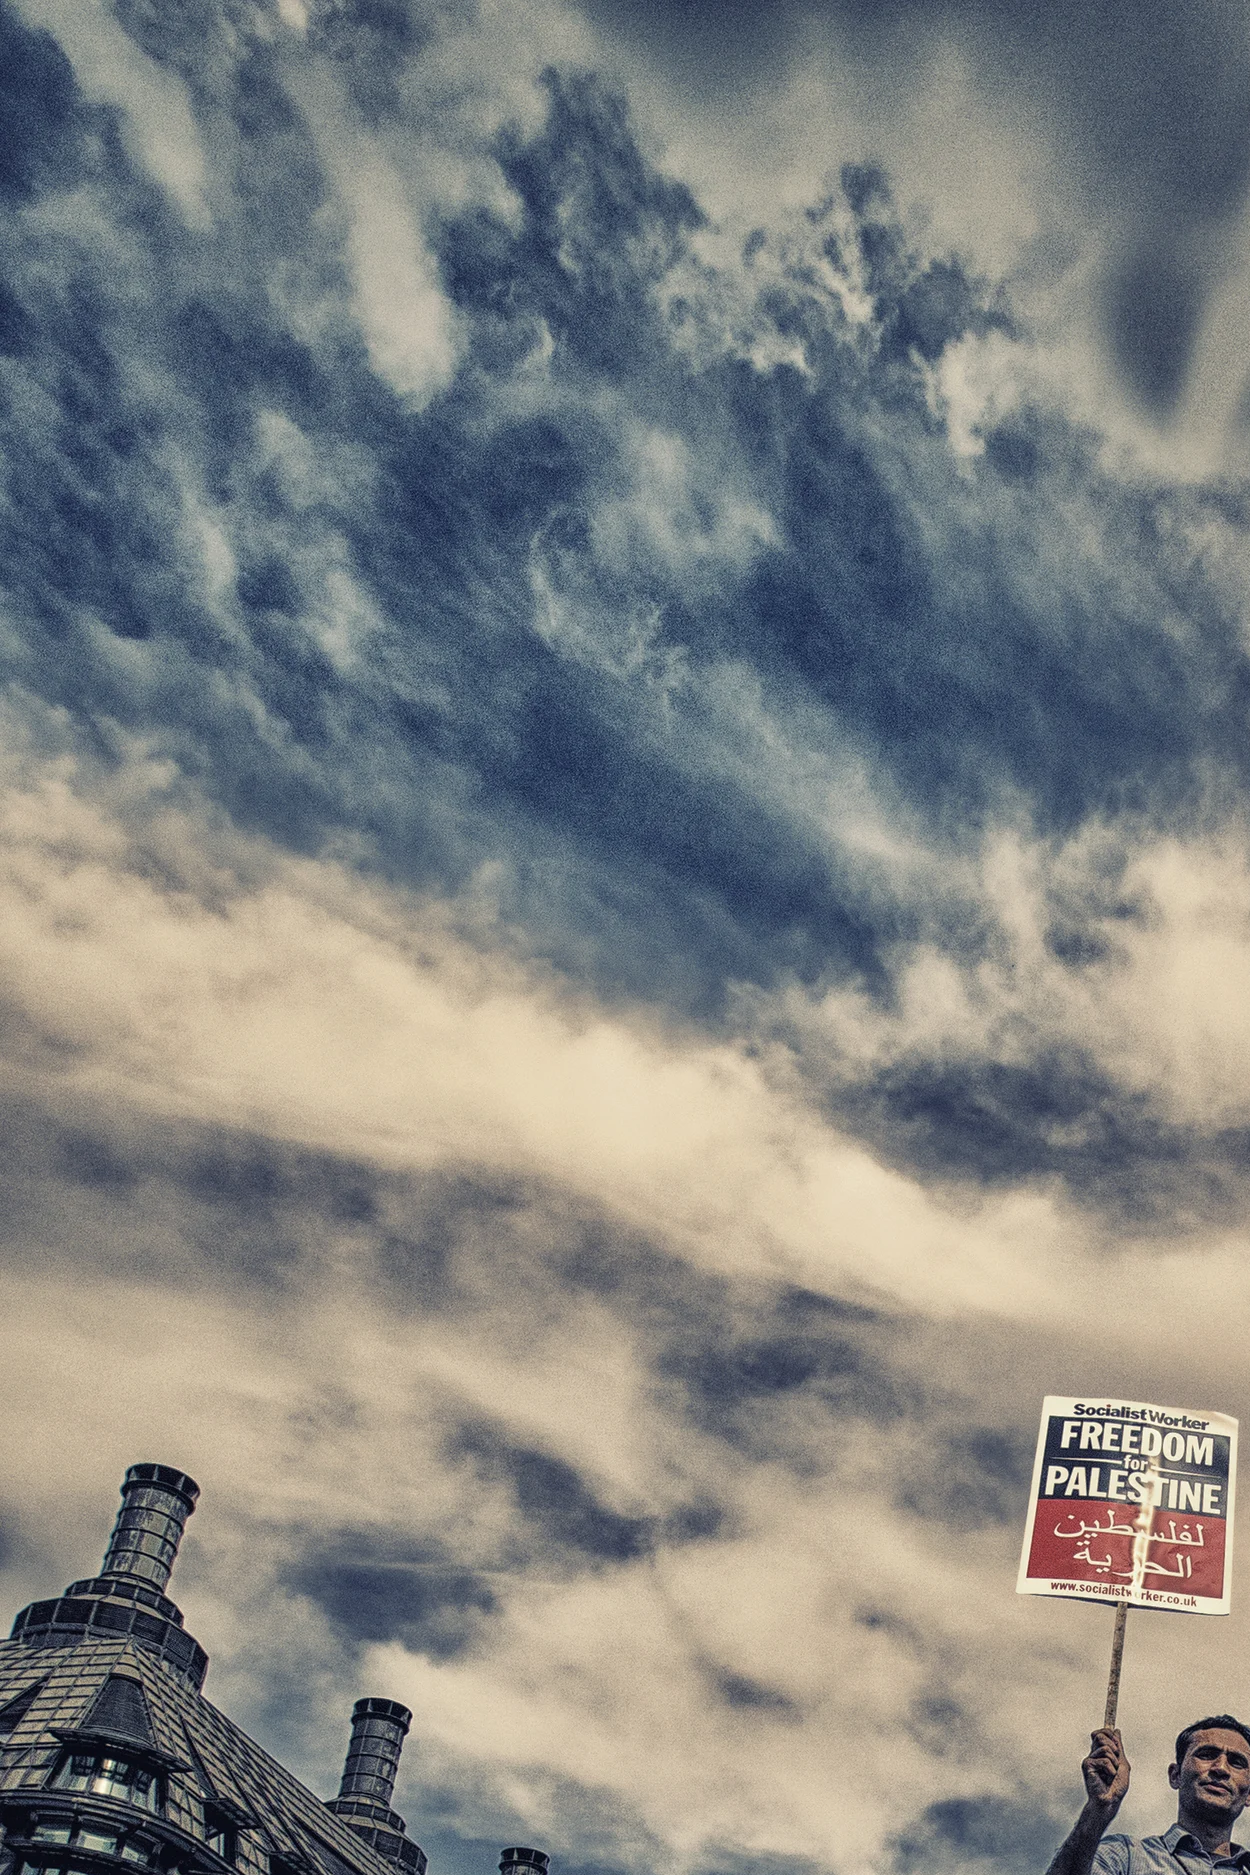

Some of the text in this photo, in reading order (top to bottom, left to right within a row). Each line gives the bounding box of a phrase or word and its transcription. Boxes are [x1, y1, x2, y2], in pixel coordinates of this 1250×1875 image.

[1060, 1420, 1214, 1466] FREEDOM
[1124, 1454, 1148, 1471] for
[1045, 1465, 1221, 1514] PALESTINE
